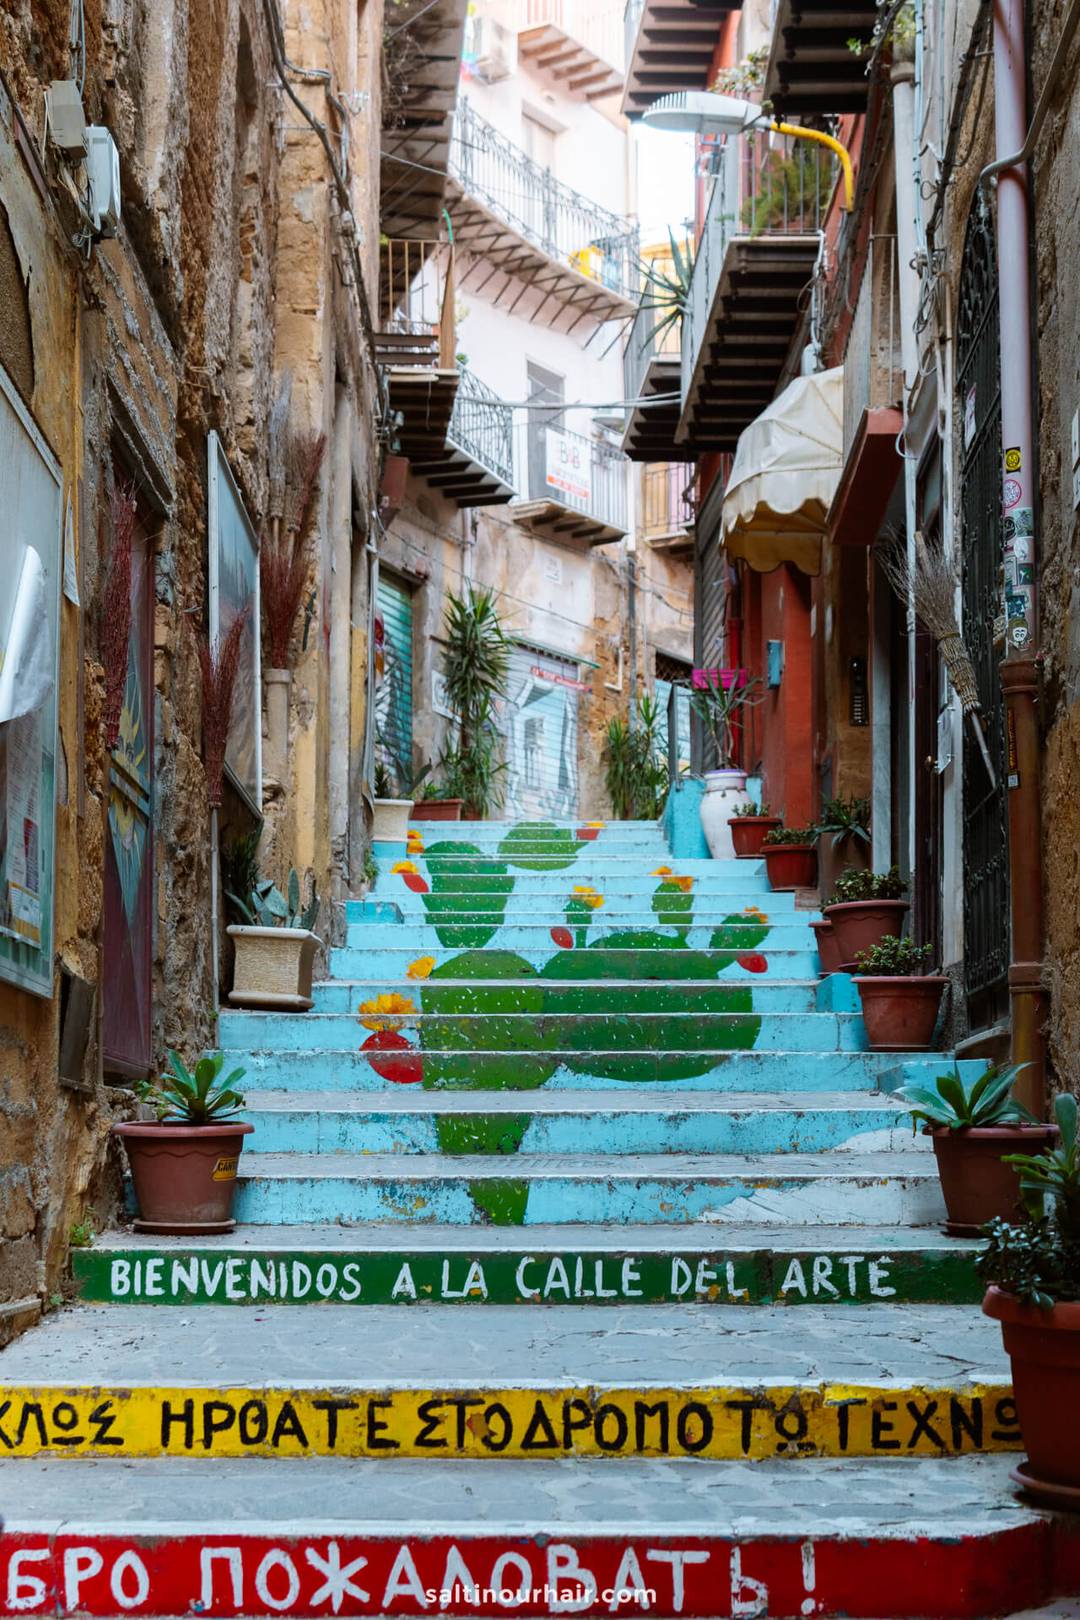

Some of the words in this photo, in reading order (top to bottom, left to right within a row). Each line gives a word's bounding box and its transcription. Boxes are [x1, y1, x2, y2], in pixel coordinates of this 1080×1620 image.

[111, 1257, 361, 1300] BIENVENIDOS
[392, 1262, 417, 1299] A
[440, 1259, 488, 1298] LA
[515, 1256, 643, 1299] CALLE
[670, 1256, 749, 1296] DEL
[780, 1255, 897, 1299] ARTE
[5, 1546, 150, 1612] БРО
